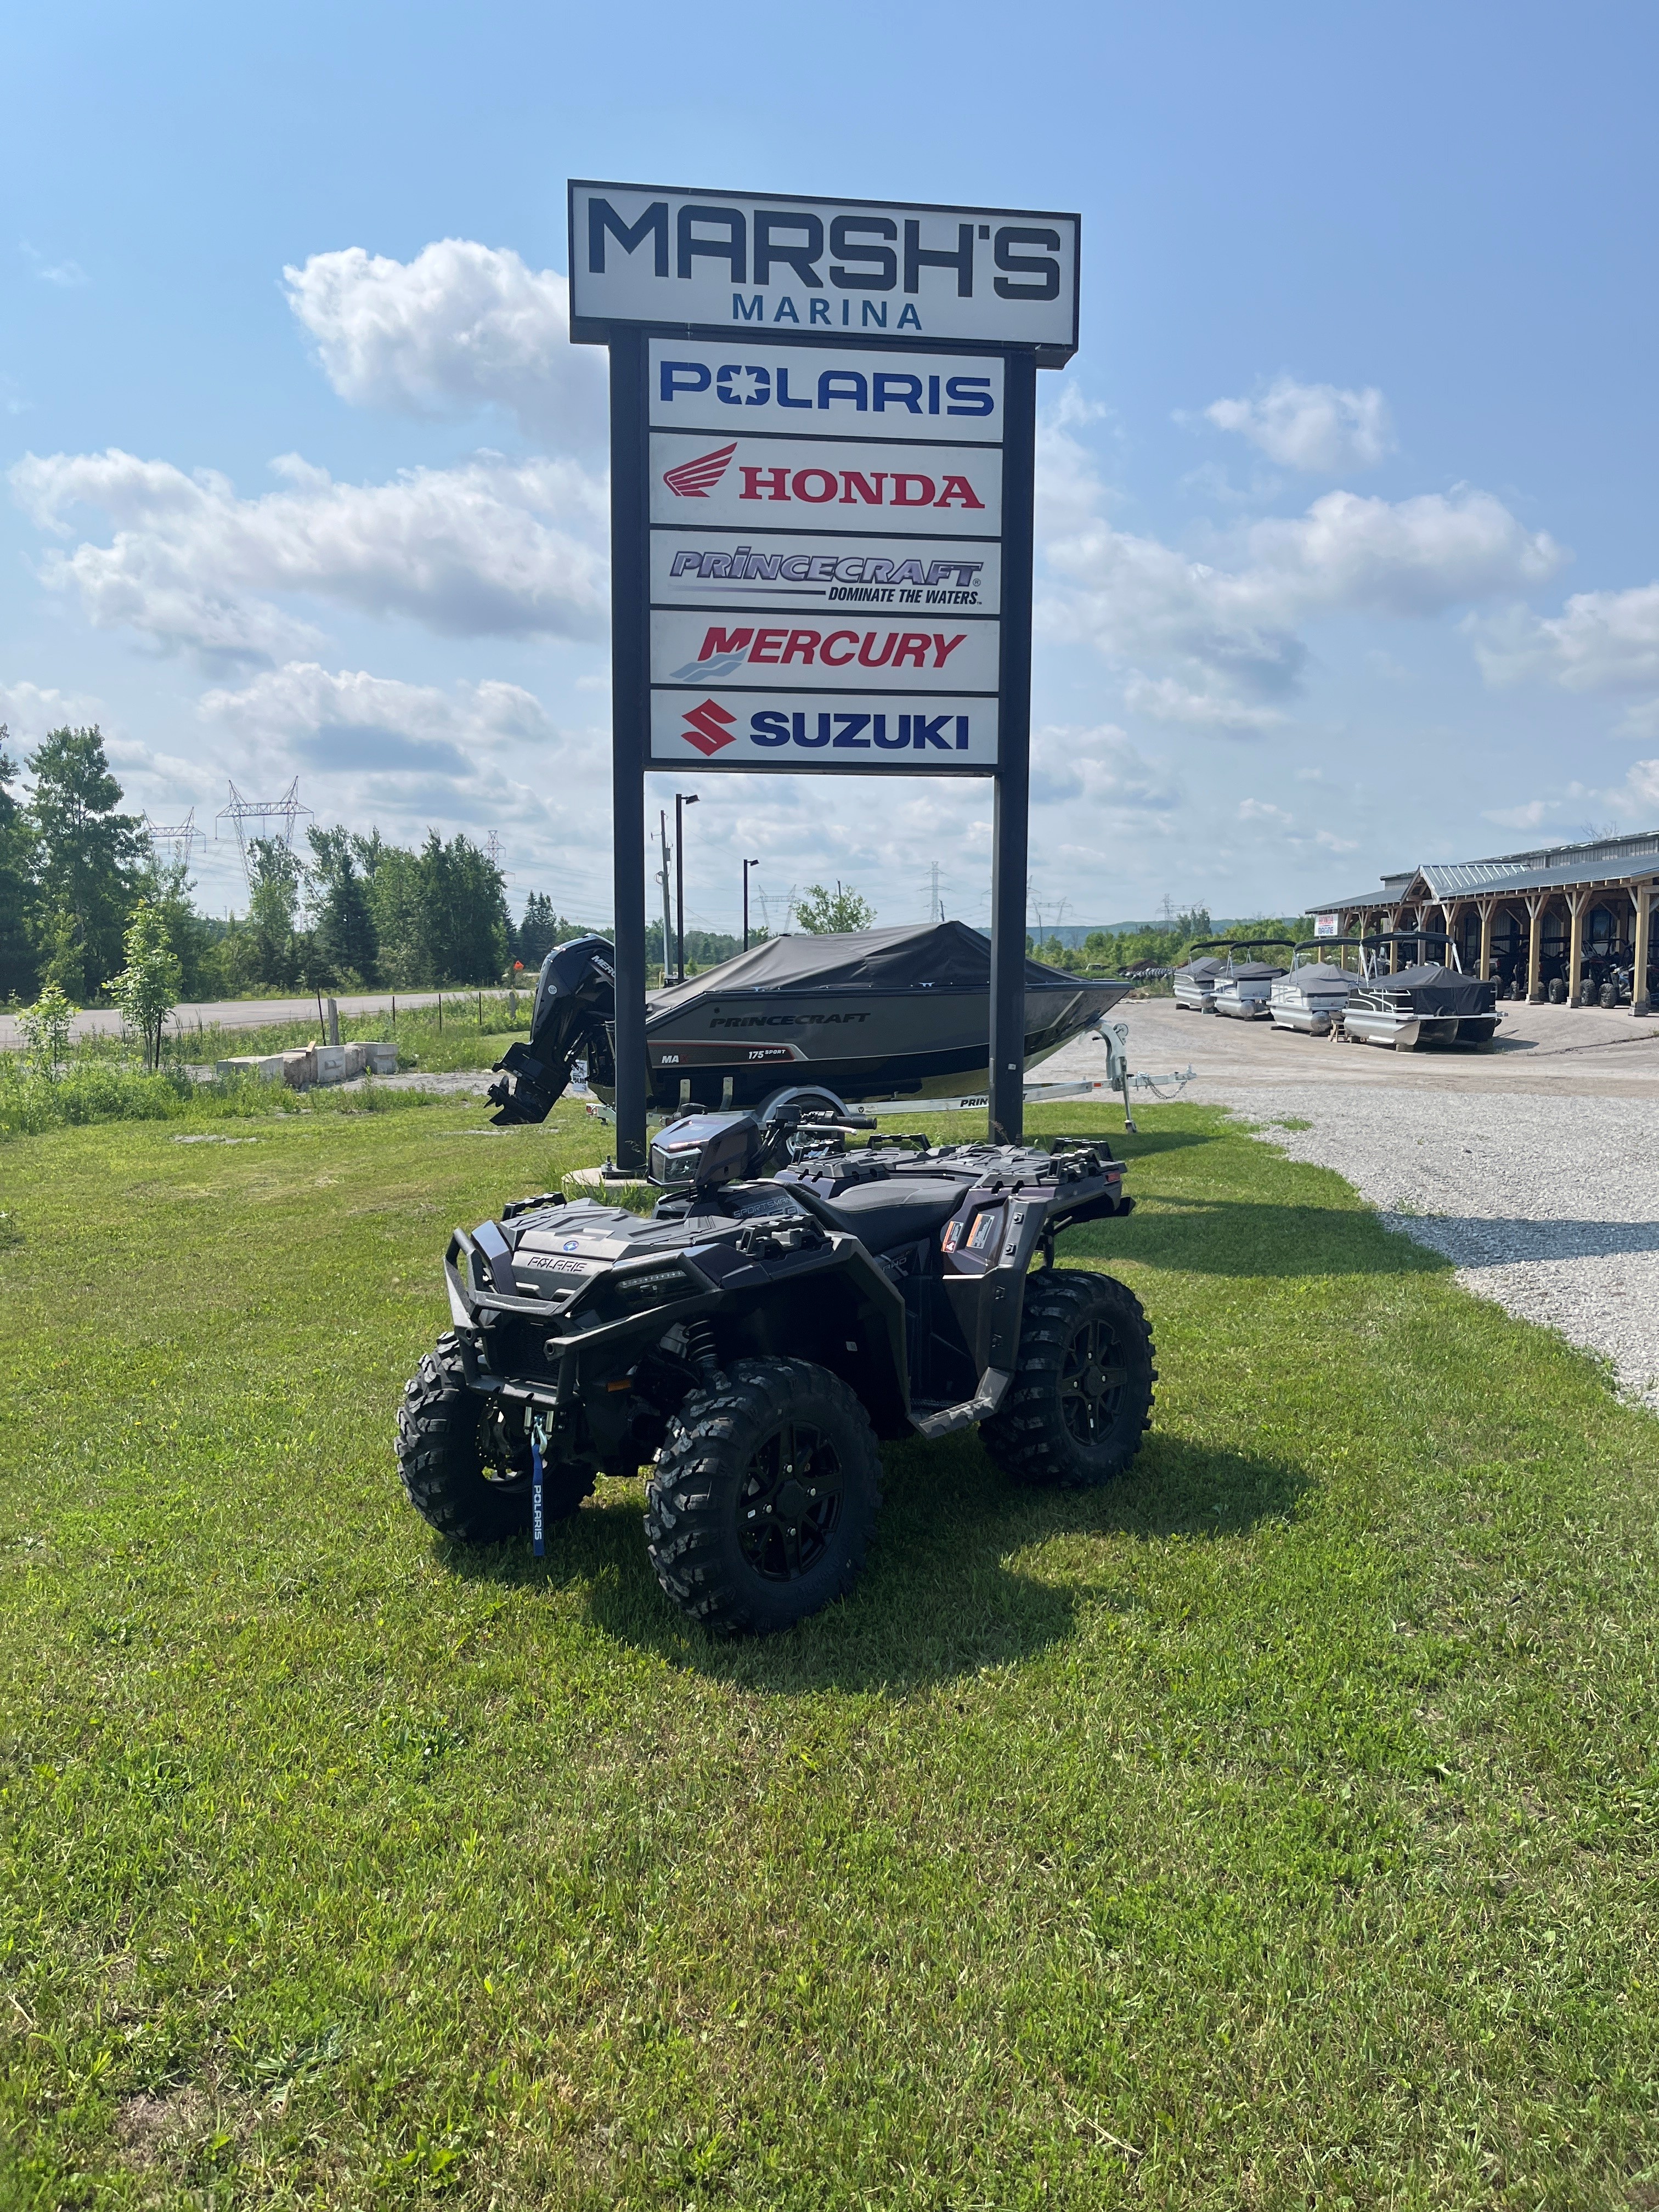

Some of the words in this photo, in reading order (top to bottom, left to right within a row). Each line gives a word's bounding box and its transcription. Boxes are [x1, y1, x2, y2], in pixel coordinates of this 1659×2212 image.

[588, 198, 1060, 301] MARSH'S
[732, 293, 922, 330] MARINA
[660, 360, 994, 416] POLARIS
[739, 466, 985, 509] HONDA
[828, 586, 895, 602] DOMINATE
[899, 589, 922, 603] THE
[697, 627, 967, 668] MERCURY
[749, 710, 969, 750] SUZUKI
[709, 1013, 871, 1028] PRINCECRAFT
[748, 1050, 764, 1059] 175
[733, 1197, 792, 1218] SPORTSMAN
[527, 1257, 587, 1272] POLARIS
[534, 1485, 542, 1540] POLARIS
